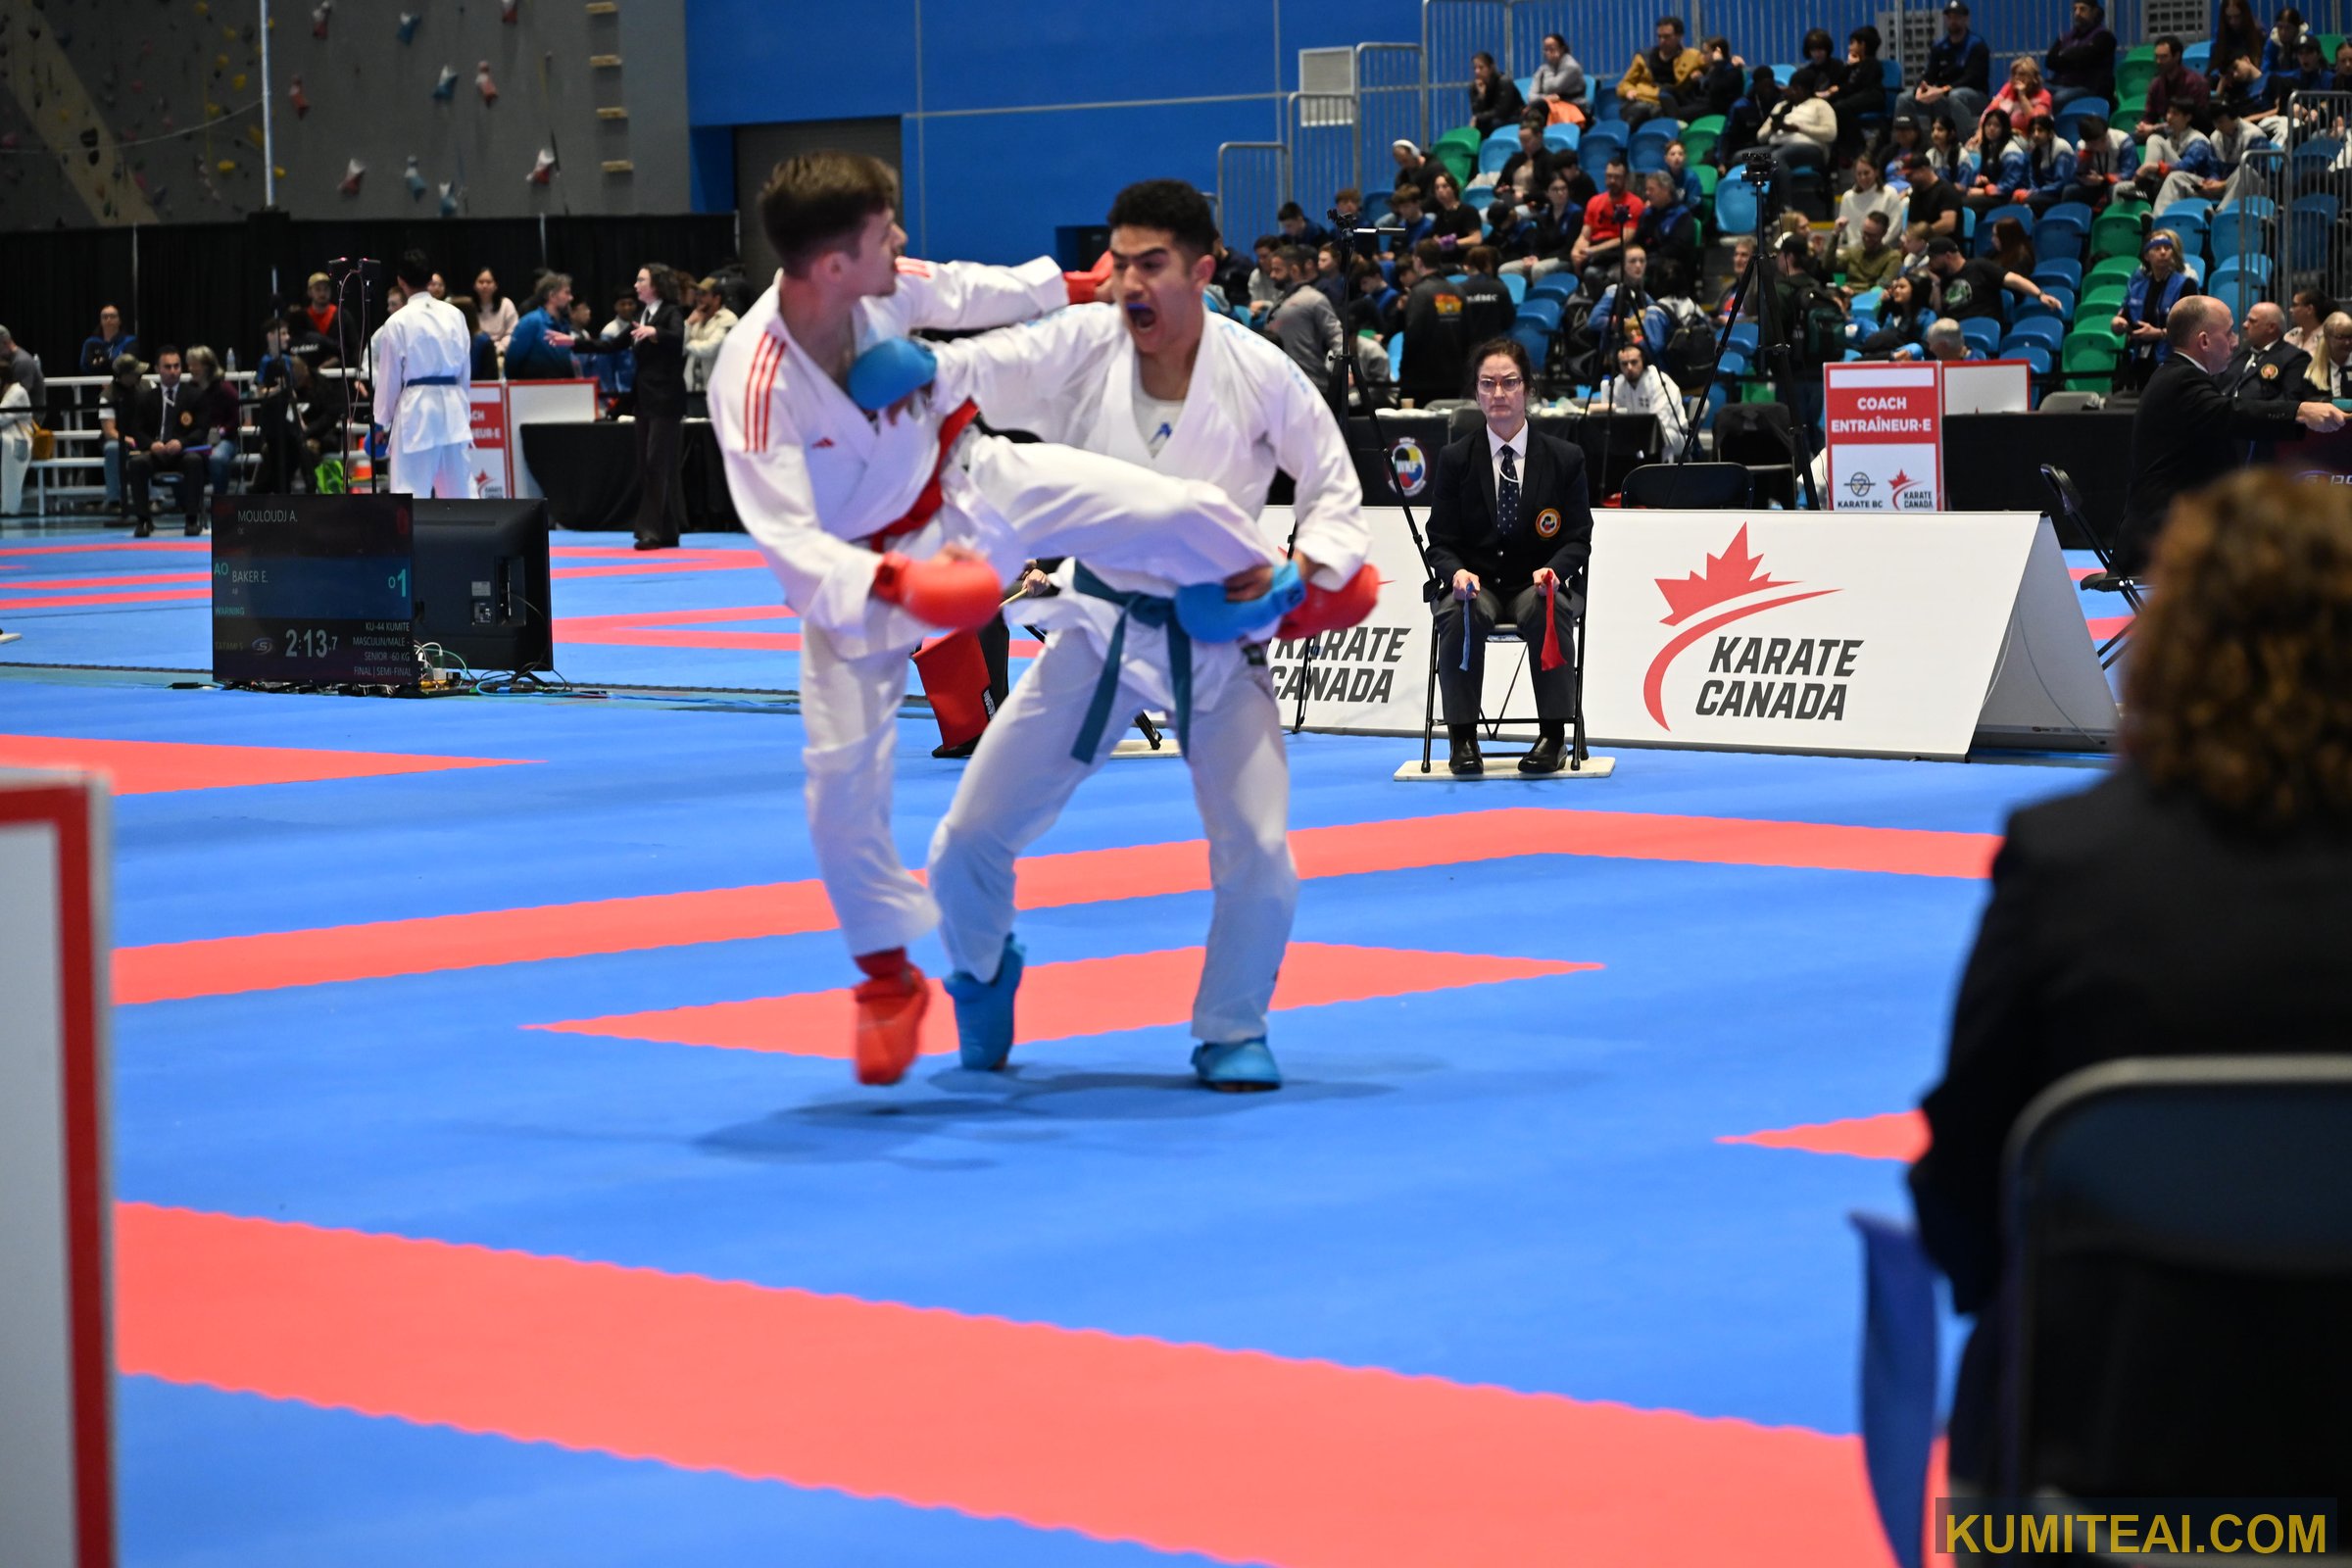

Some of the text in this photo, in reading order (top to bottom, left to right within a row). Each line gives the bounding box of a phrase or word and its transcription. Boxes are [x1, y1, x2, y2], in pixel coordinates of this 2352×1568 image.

[1857, 397, 1907, 411] COACH
[1904, 491, 1933, 500] KARATE
[1838, 500, 1884, 509] KARATE BC
[1904, 500, 1933, 509] CANADA
[214, 563, 228, 576] AO
[232, 570, 259, 583] BAKER
[385, 621, 410, 632] KUMITE
[364, 651, 388, 662] SENIOR
[401, 651, 411, 662] KG
[1708, 636, 1865, 677] KARATE
[354, 665, 372, 676] FINAL
[376, 666, 413, 677] SEMI-FINAL
[1269, 665, 1395, 704] CANADA
[1695, 680, 1847, 721] CANADA
